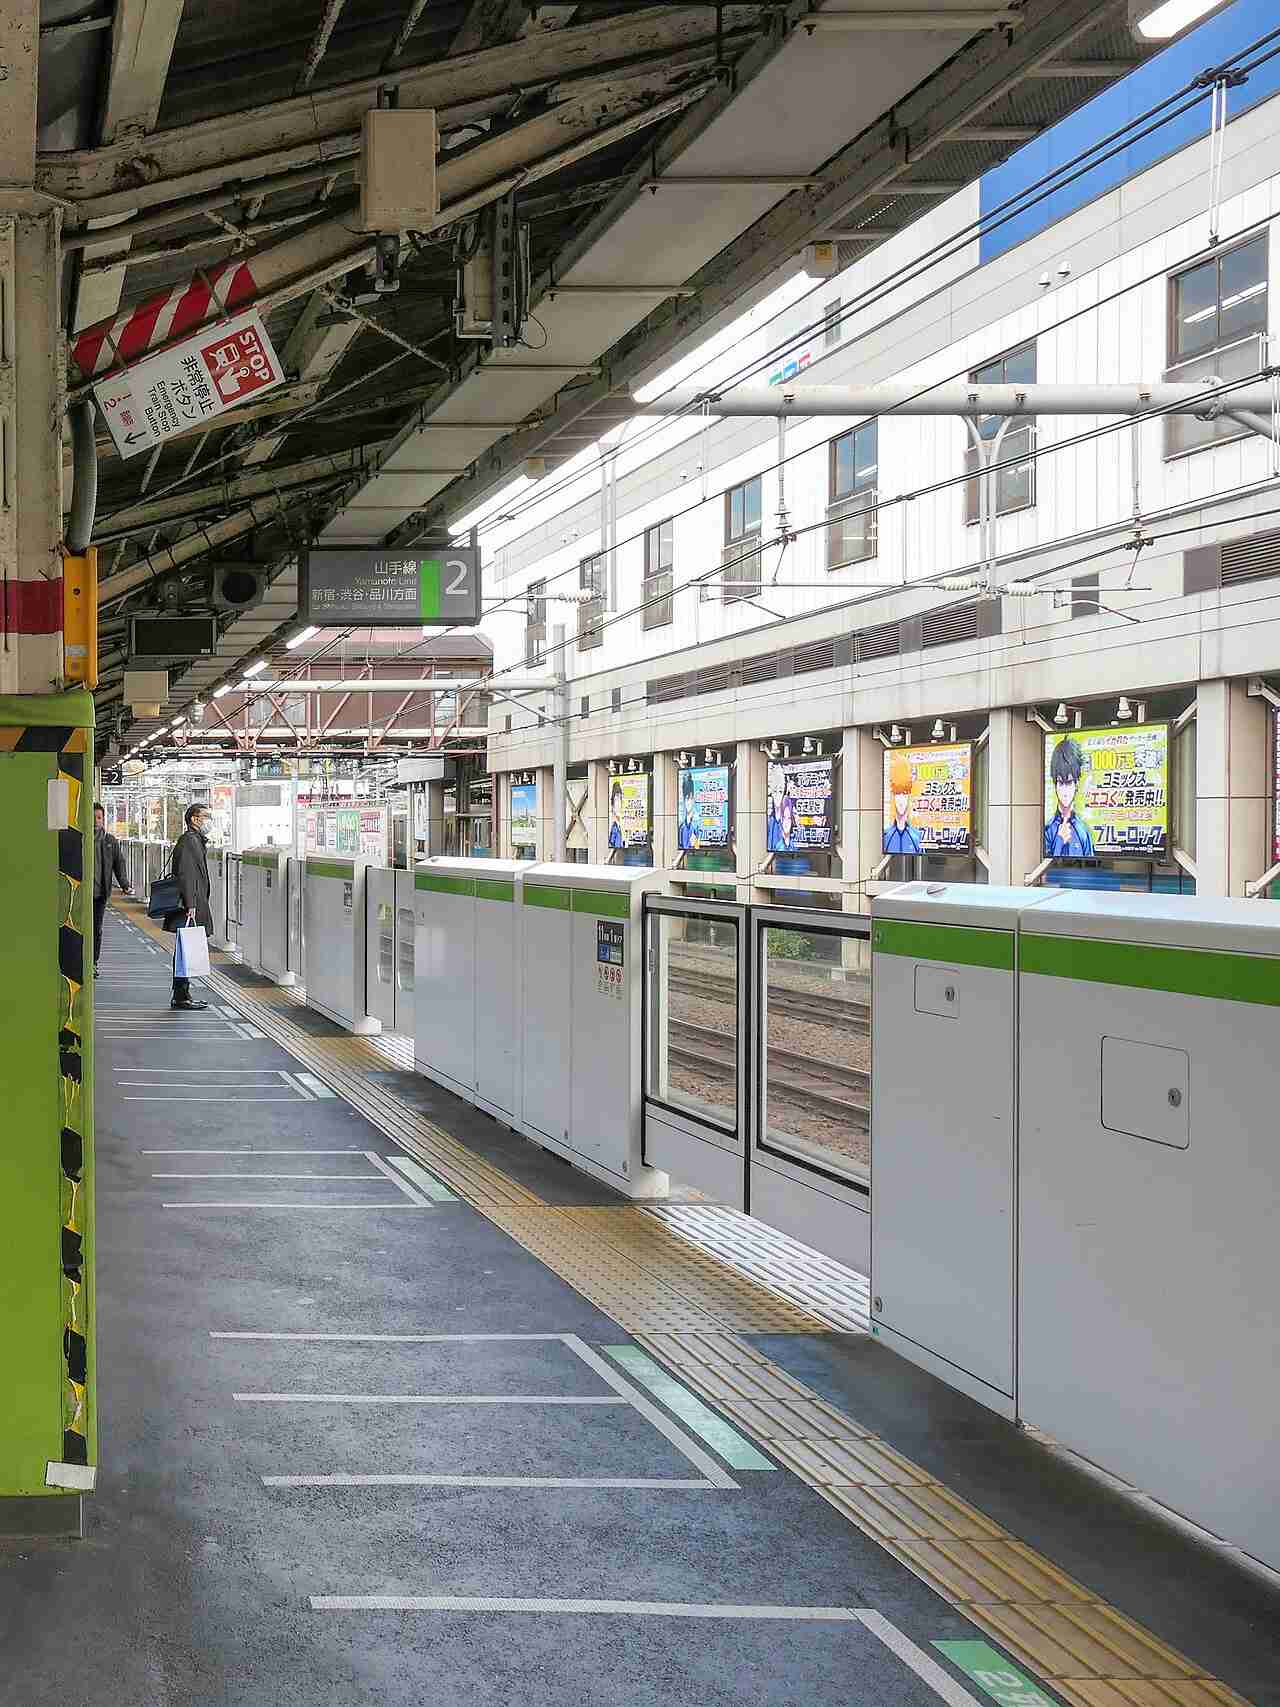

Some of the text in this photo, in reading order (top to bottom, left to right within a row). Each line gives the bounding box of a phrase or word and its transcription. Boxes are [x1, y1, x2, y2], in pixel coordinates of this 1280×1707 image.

[240, 331, 271, 381] STOP
[156, 380, 180, 428] Emergency
[171, 380, 197, 419] ボタン
[180, 355, 216, 416] 非常停止
[144, 407, 161, 437] Button
[147, 388, 171, 433] Train Stop
[375, 560, 417, 575] 山手線
[445, 560, 468, 595] 2
[111, 771, 119, 784] 2
[1103, 771, 1147, 787] コミックス
